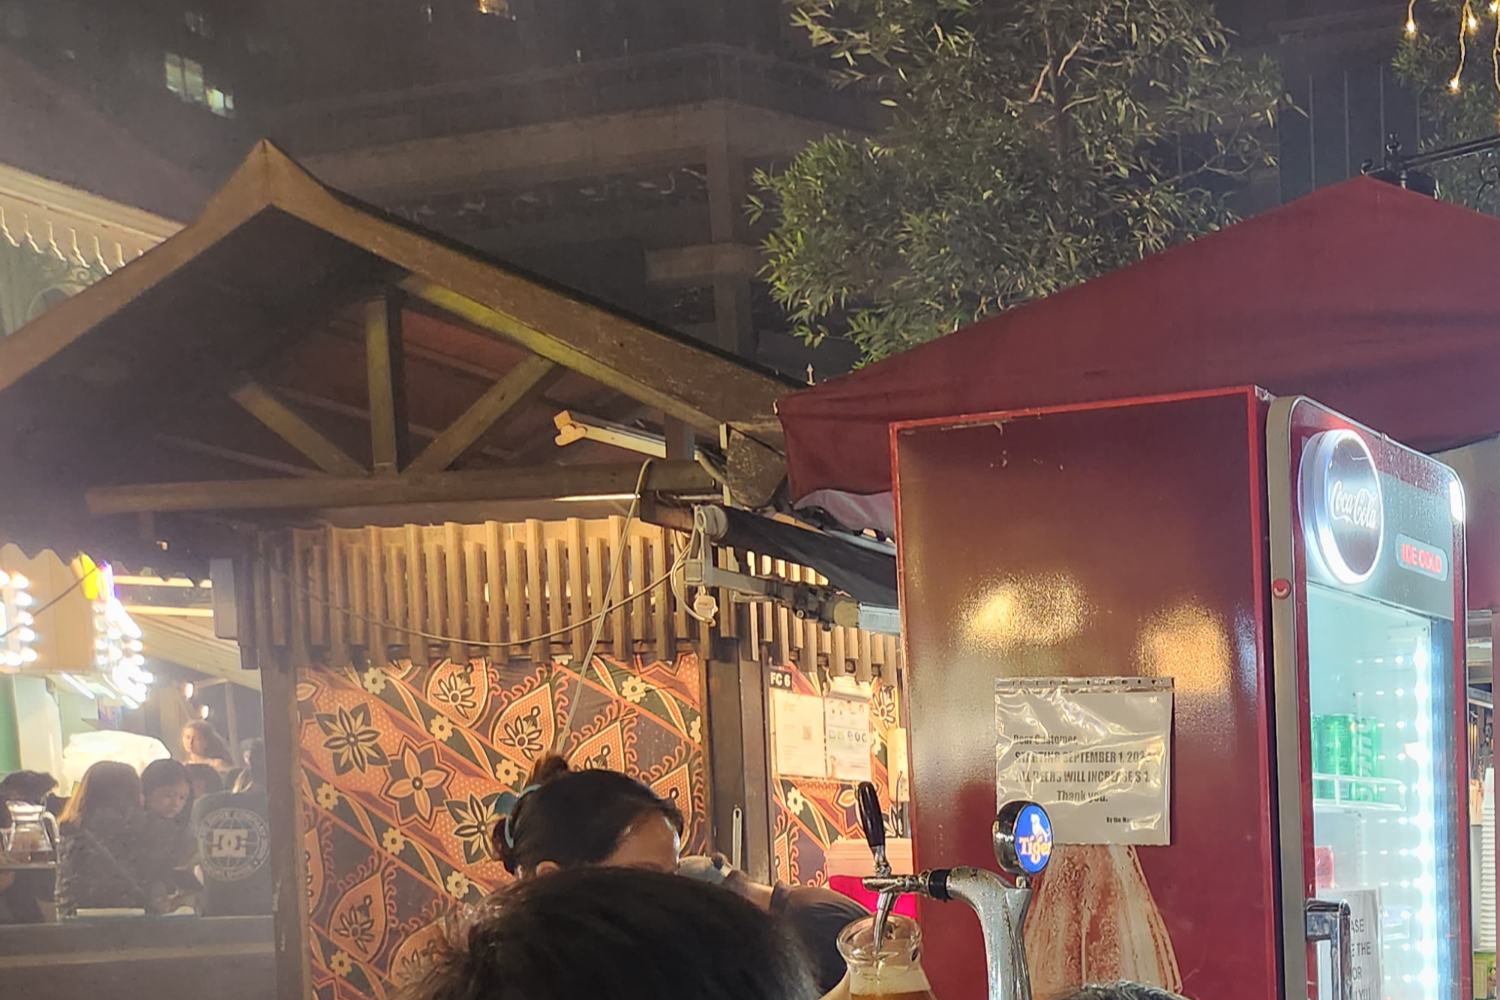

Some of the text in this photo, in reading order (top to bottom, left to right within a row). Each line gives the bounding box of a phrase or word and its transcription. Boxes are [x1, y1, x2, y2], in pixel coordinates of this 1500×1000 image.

[1331, 480, 1378, 530] Coca-Cola
[1402, 543, 1442, 573] ICE COLD
[770, 671, 791, 687] FC 6
[1063, 751, 1116, 764] SEPTEMBER
[1064, 770, 1086, 783] WILL
[1088, 770, 1134, 784] INCREASE
[1057, 790, 1086, 801] Thank
[1357, 942, 1371, 957] THE
